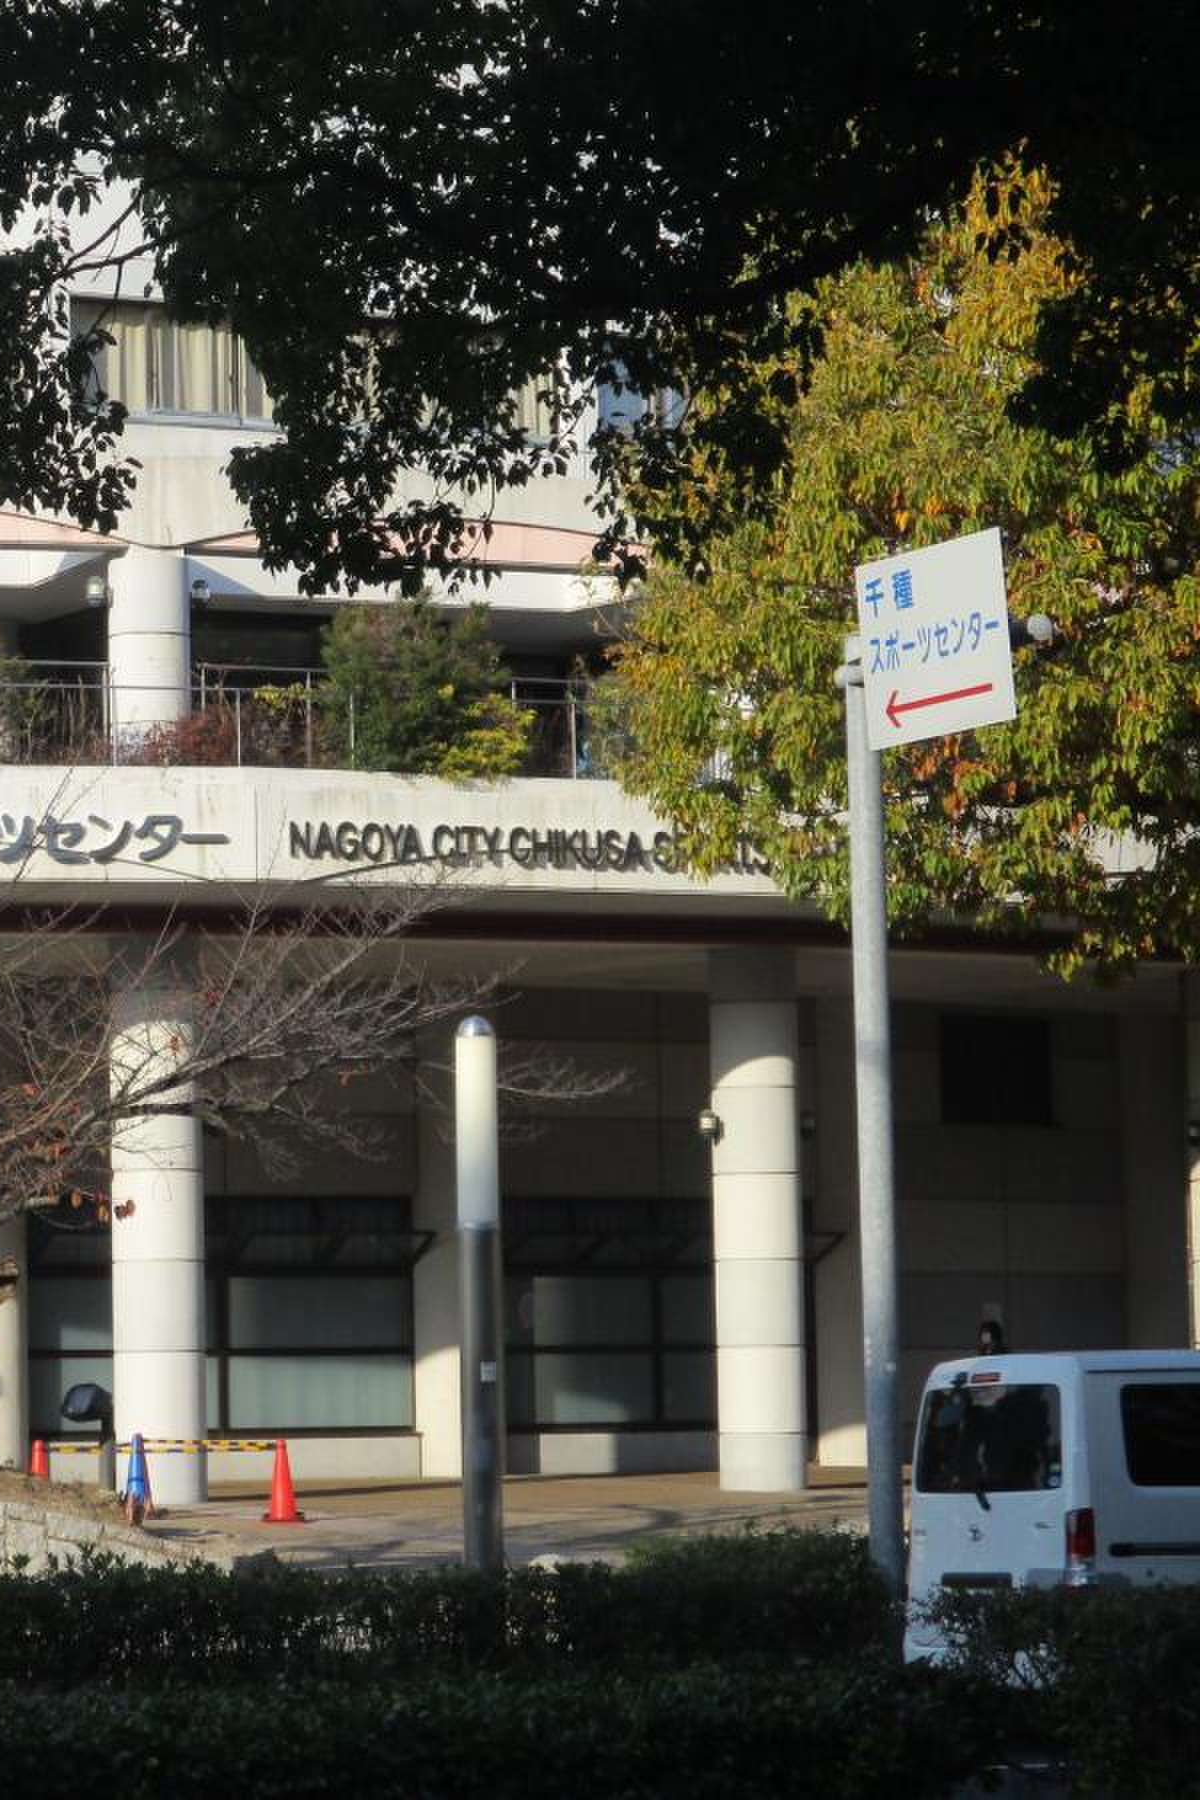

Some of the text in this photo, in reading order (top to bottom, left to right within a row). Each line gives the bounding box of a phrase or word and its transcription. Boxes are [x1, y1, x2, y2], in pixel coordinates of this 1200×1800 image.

[863, 568, 915, 618] 千種
[868, 611, 1001, 675] スポーツセンター
[289, 821, 422, 862] NAGOYA
[431, 824, 503, 868] CITY
[509, 826, 647, 872] CHIKUSA
